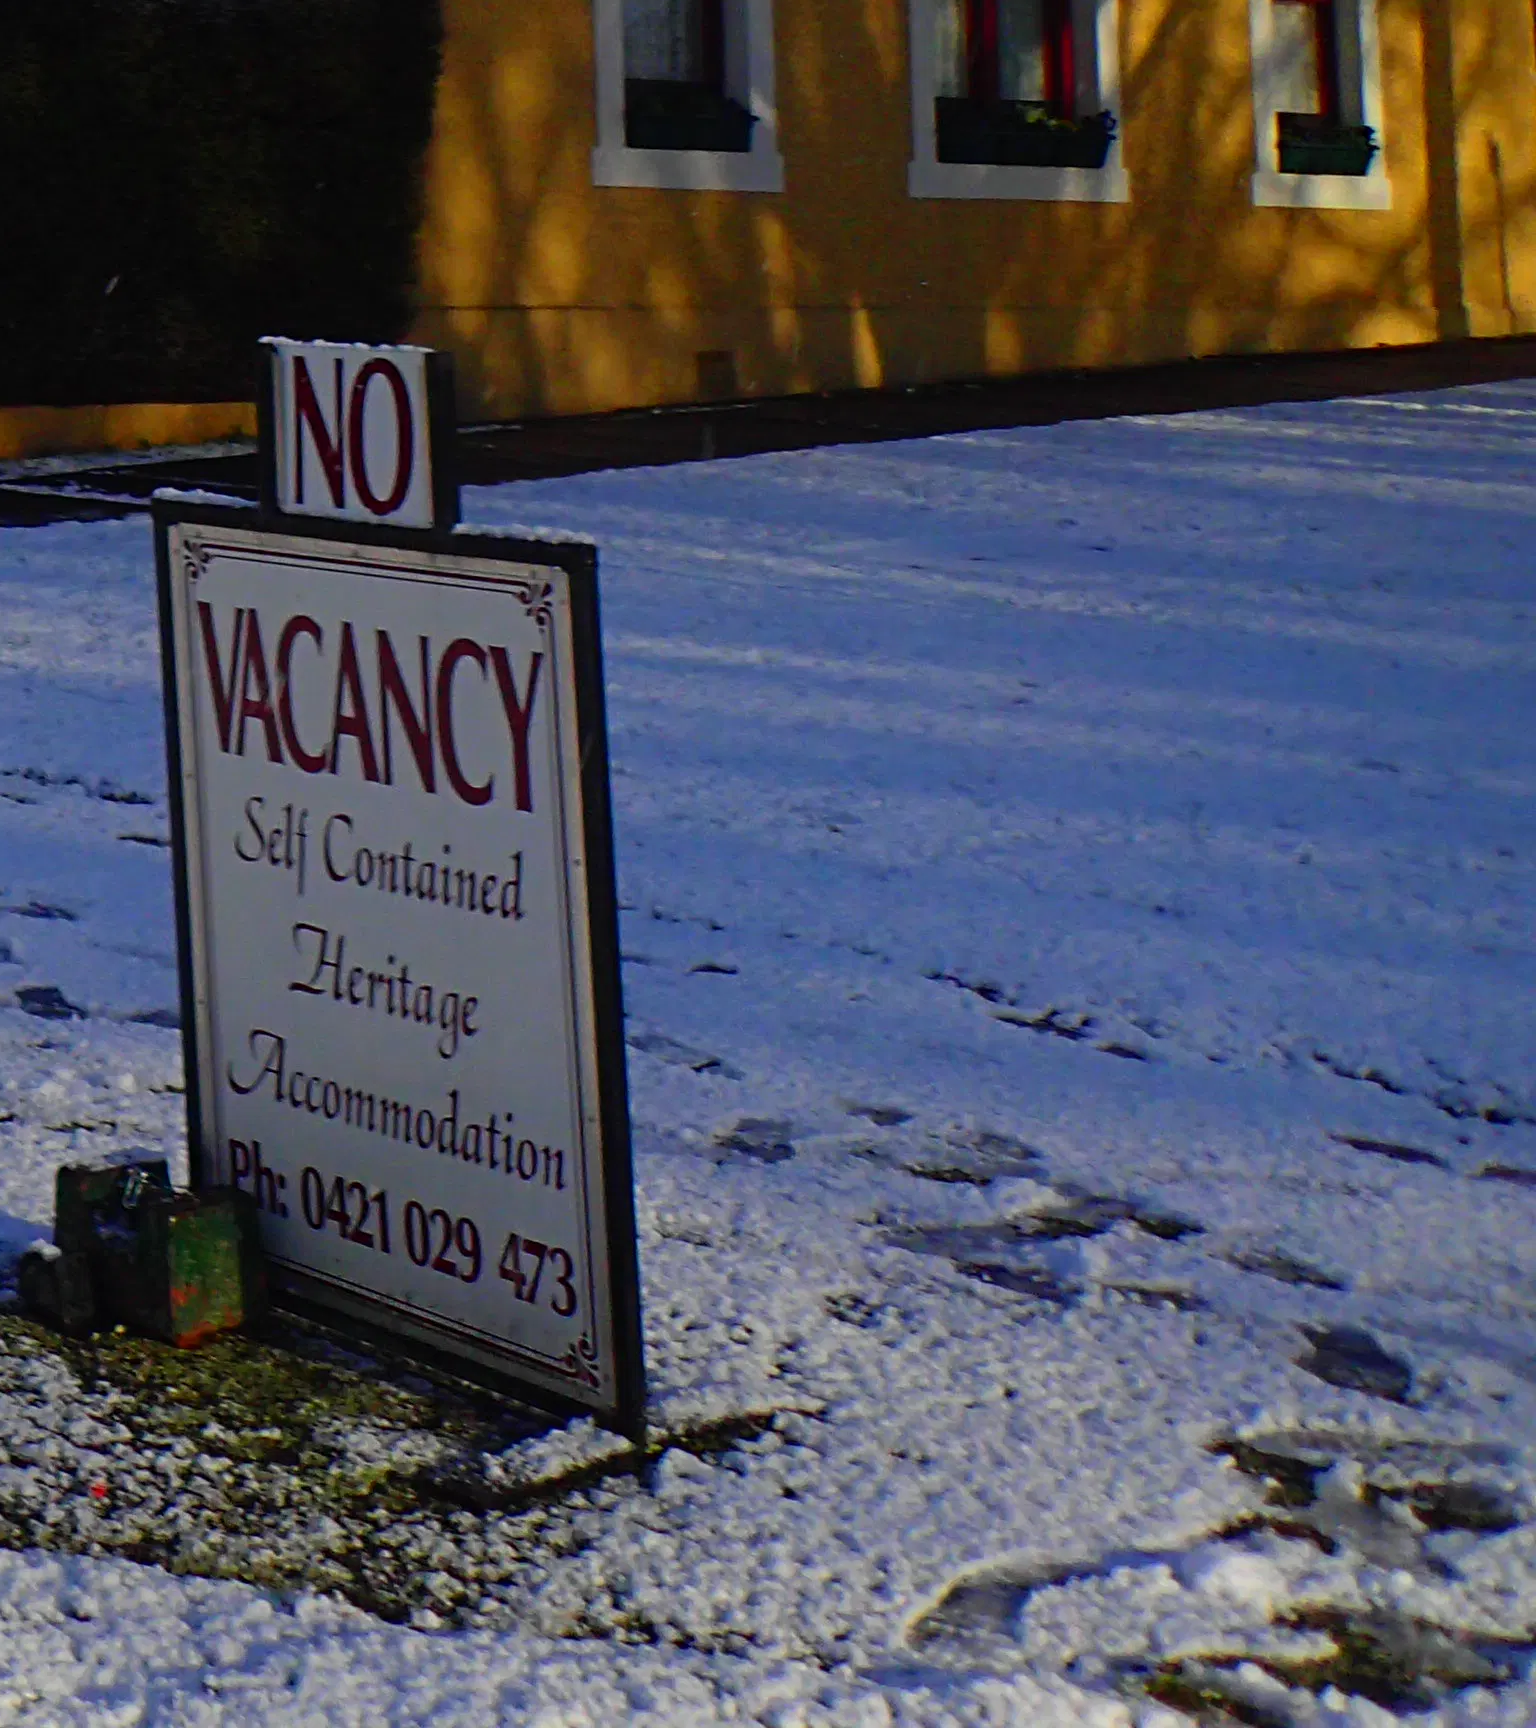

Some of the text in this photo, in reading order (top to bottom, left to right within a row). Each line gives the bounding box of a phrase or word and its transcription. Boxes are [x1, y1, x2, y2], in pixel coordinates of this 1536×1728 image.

[294, 355, 413, 515] NO
[197, 601, 543, 813] VACANCY
[234, 795, 525, 921] Self Contained
[289, 922, 478, 1059] Heritage
[228, 1029, 568, 1190] Accommodation
[230, 1138, 578, 1318] Ph: 0421 029 473
